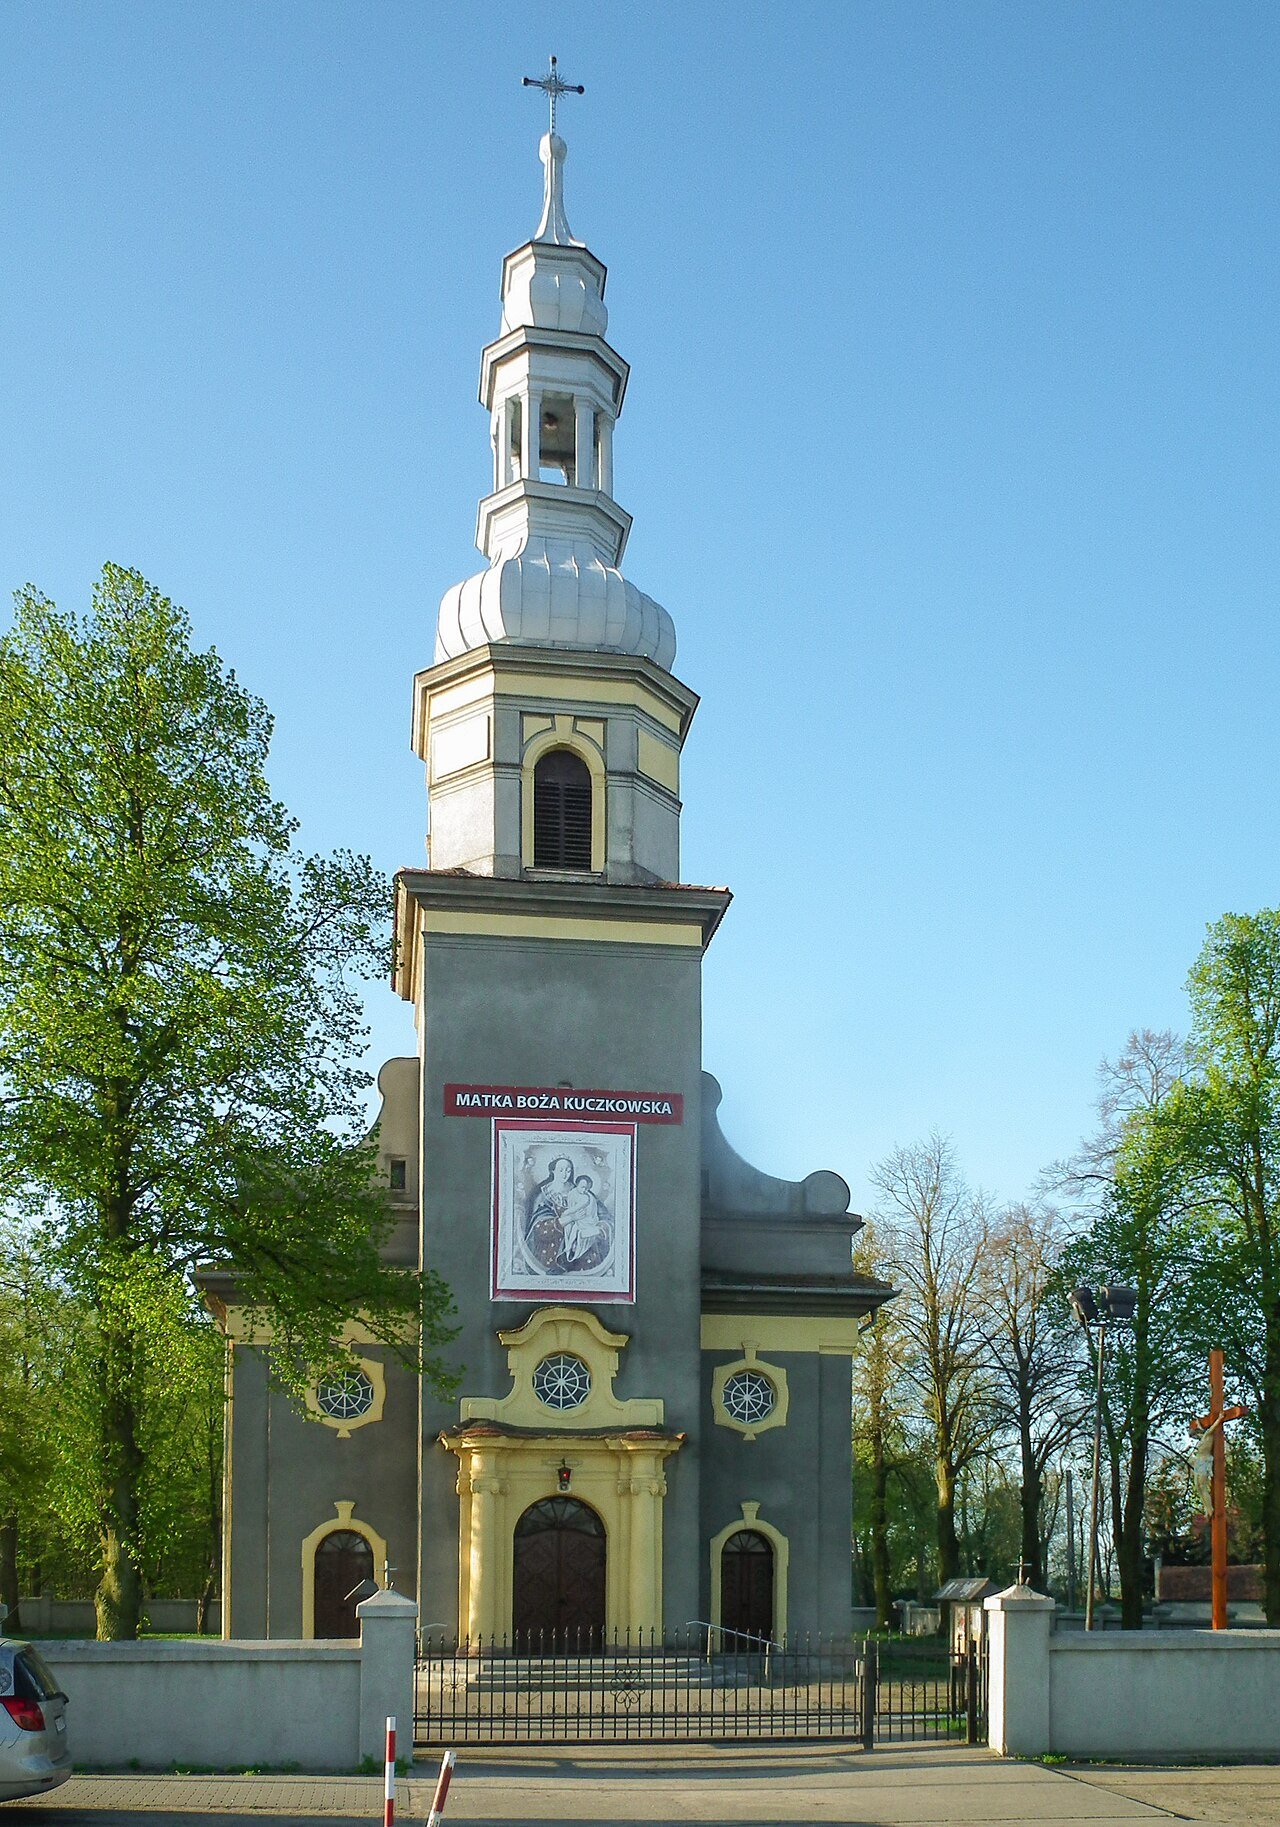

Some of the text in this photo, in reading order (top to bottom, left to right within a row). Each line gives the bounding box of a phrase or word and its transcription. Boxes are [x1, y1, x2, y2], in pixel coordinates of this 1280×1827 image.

[456, 1093, 672, 1114] MATKA BOŻA KUCZKOWSKA
